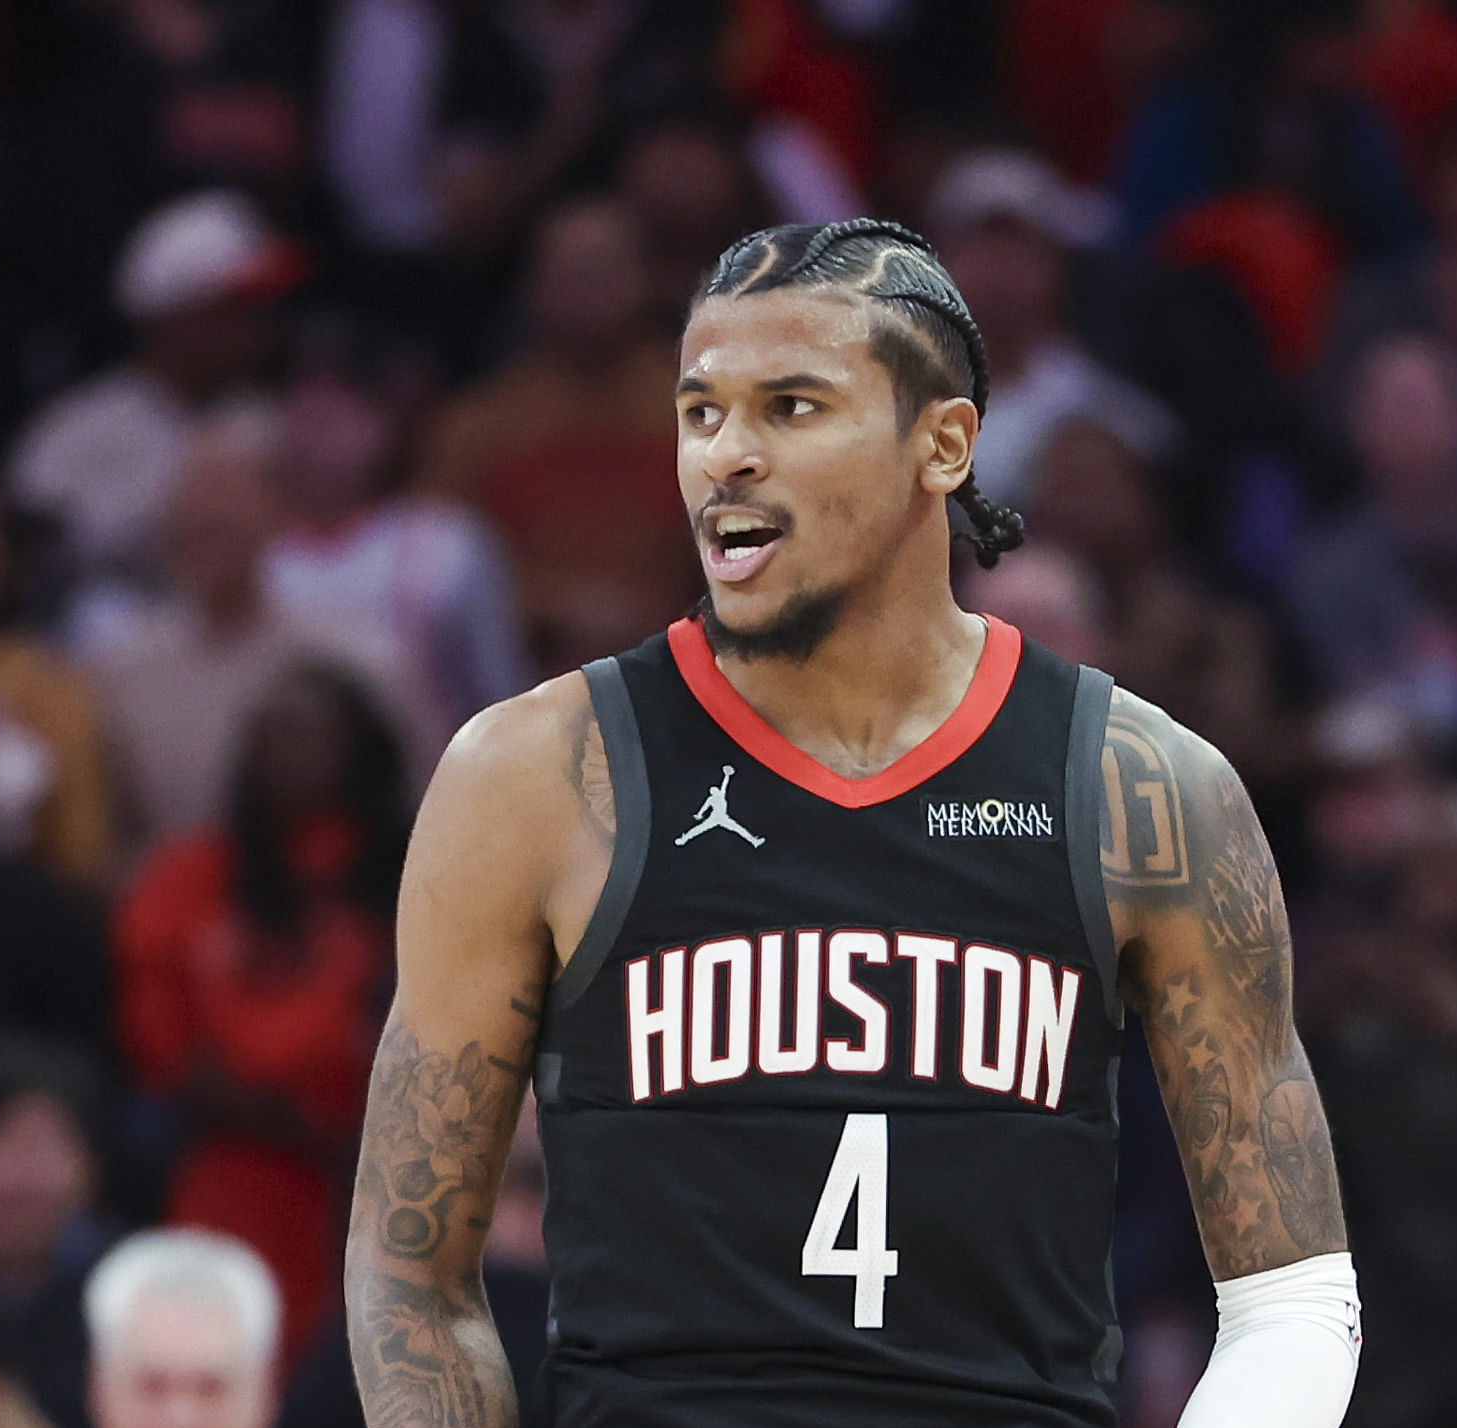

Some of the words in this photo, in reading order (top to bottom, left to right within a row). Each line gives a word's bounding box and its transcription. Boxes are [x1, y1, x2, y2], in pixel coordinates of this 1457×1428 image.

[927, 798, 1053, 823] MEMORIAL
[928, 818, 1053, 837] HERMANN
[624, 928, 1082, 1112] HOUSTON
[800, 1112, 899, 1329] 4
